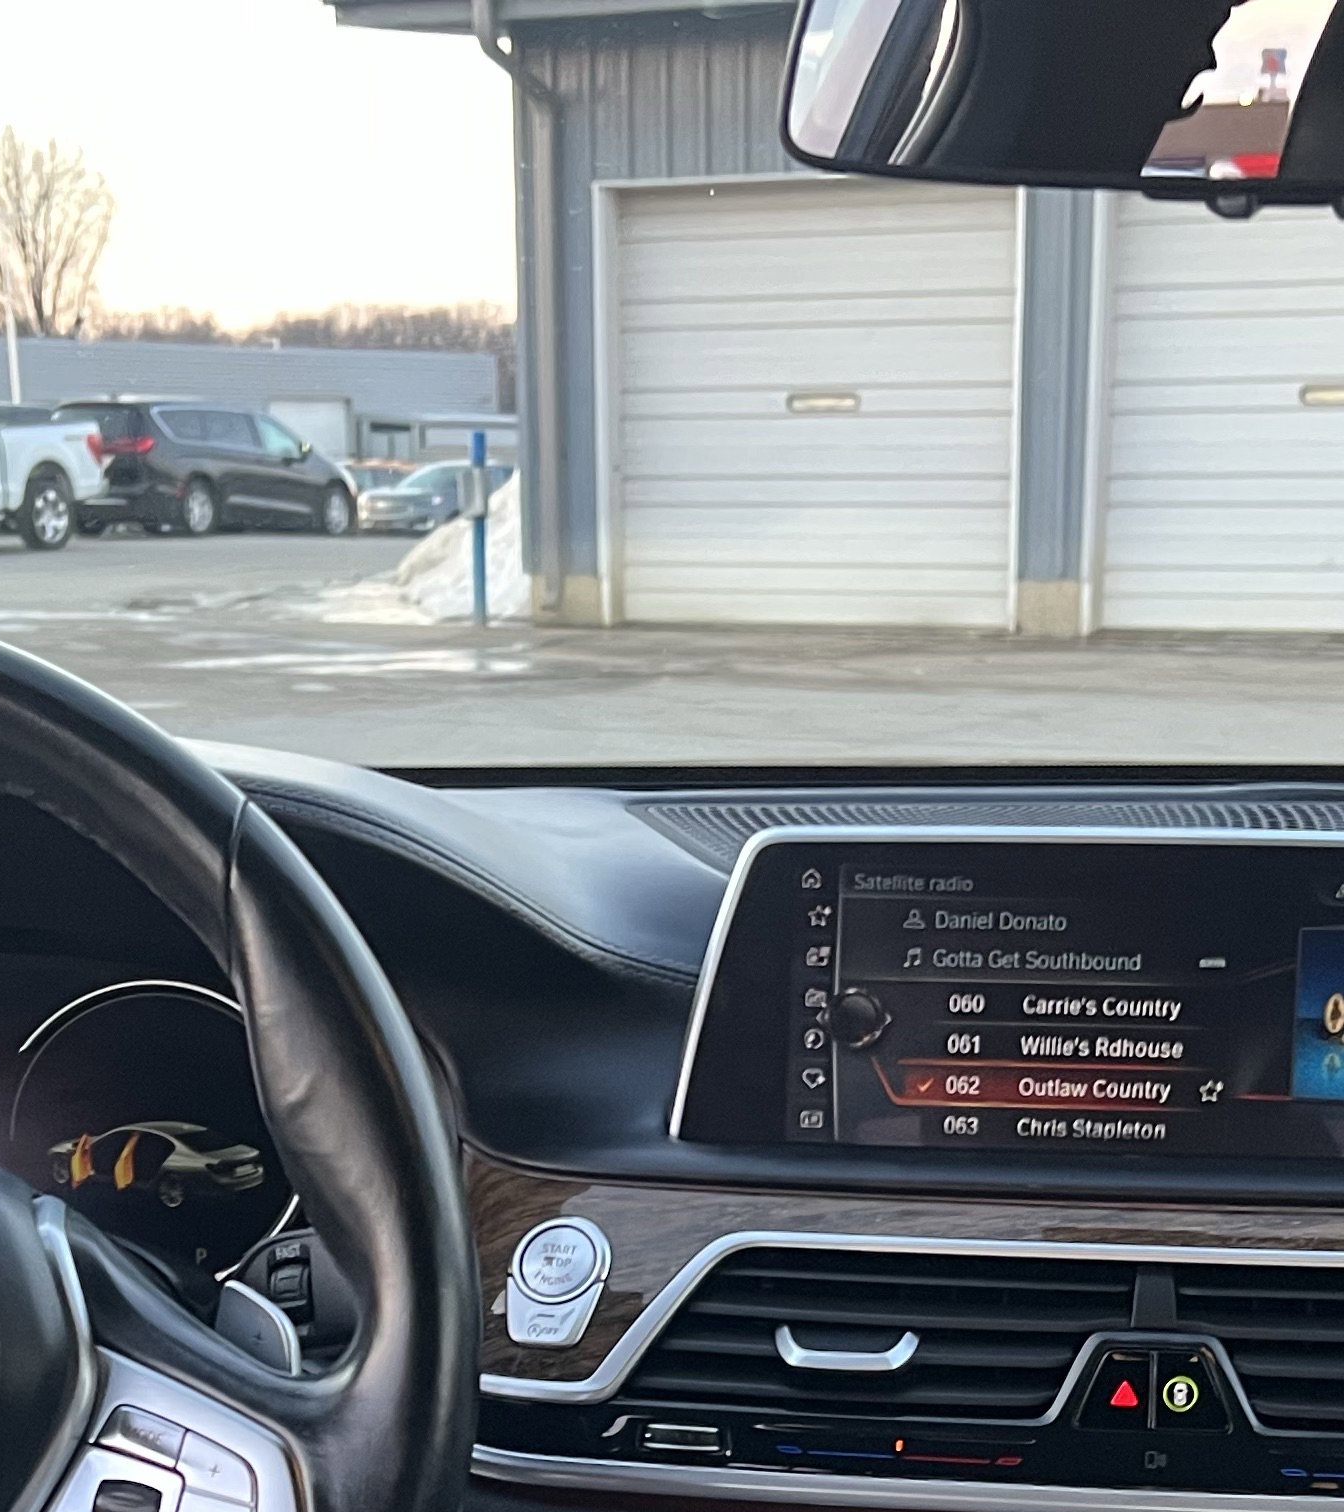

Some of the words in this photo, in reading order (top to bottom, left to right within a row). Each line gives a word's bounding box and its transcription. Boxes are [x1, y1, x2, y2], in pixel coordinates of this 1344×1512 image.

[929, 874, 974, 893] radio
[934, 910, 993, 931] Daniel
[999, 911, 1067, 932] Donato
[932, 948, 983, 968] Gotta
[988, 949, 1020, 969] Get
[1025, 951, 1142, 972] Southbound
[948, 994, 986, 1014] 060
[1022, 994, 1097, 1017] Carrie's
[1102, 996, 1182, 1022] Country
[946, 1033, 981, 1055] 061
[1020, 1035, 1090, 1058] Willie's
[1095, 1036, 1184, 1060] Rdhouse
[945, 1075, 981, 1095] 062
[1018, 1077, 1088, 1098] Outlaw
[1092, 1079, 1171, 1104] Country
[942, 1115, 979, 1136] 063
[1016, 1117, 1068, 1138] Chris
[1072, 1118, 1166, 1141] Stapleton
[542, 1242, 577, 1256] START
